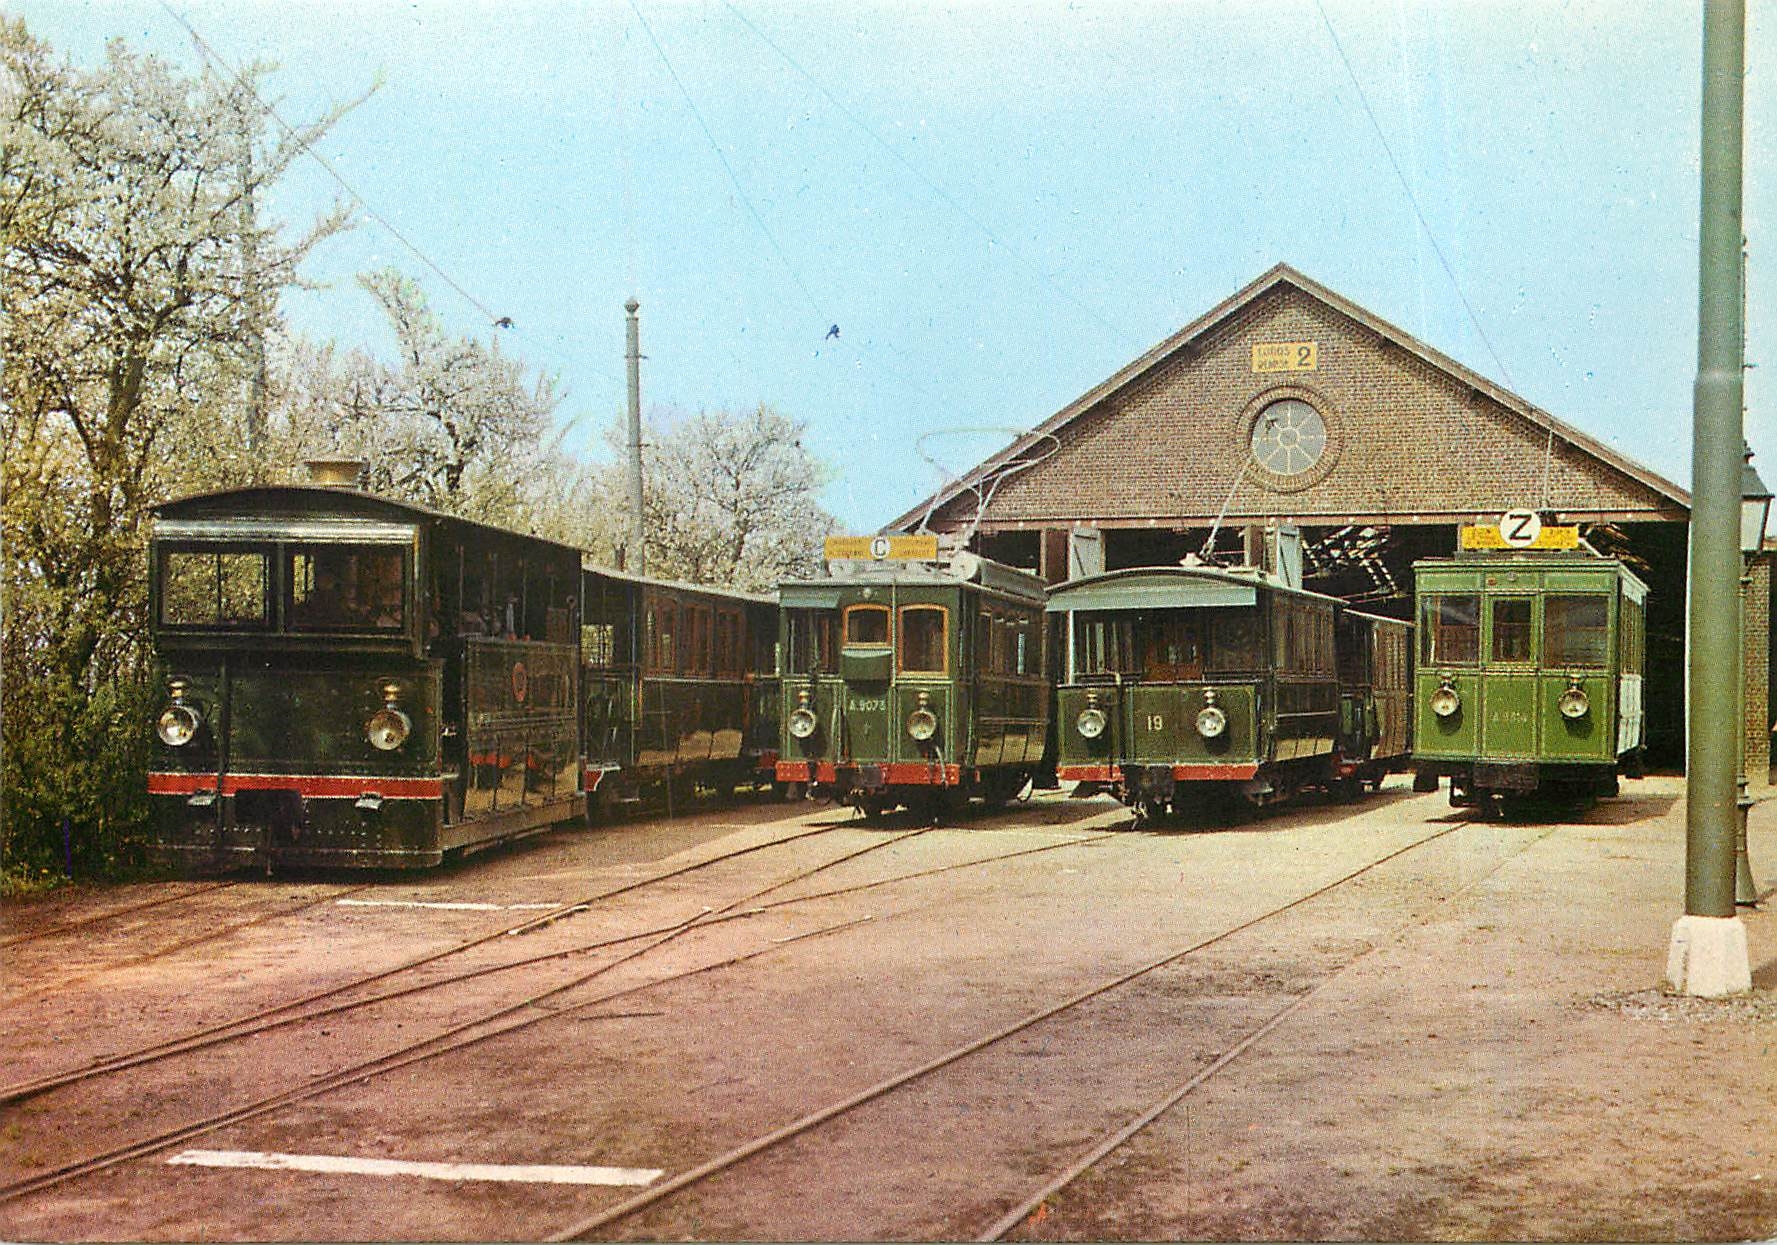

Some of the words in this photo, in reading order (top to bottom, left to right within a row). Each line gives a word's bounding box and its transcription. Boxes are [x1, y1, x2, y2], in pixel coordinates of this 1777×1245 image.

[1297, 346, 1312, 367] 2
[1508, 513, 1532, 541] Z
[874, 539, 886, 556] C
